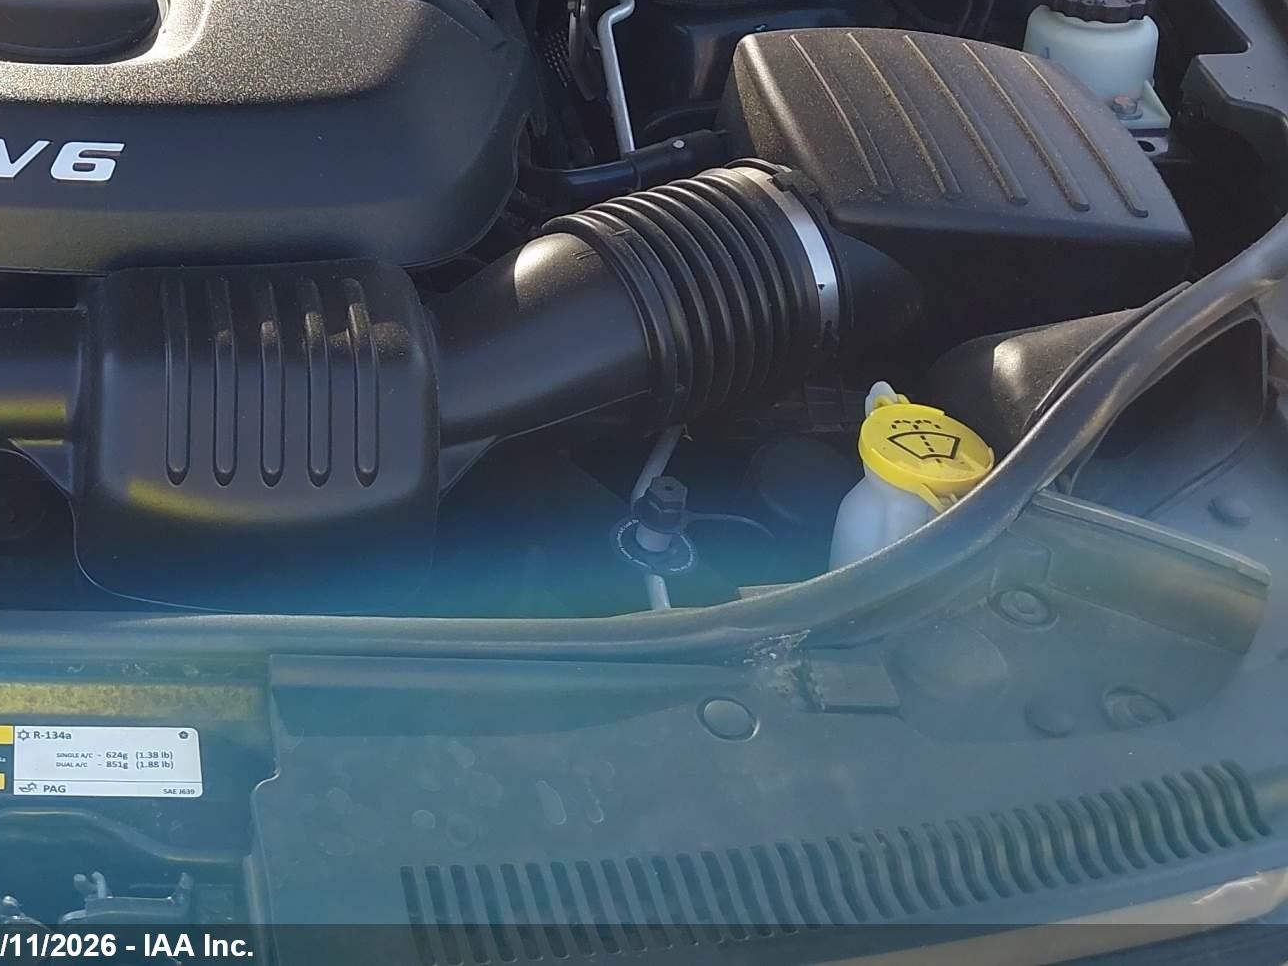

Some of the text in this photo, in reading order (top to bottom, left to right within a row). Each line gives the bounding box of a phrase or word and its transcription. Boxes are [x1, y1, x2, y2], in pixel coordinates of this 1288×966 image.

[33, 730, 72, 740] R-134a
[106, 751, 129, 760] 624g
[135, 751, 159, 760] (1.38
[161, 751, 174, 760] lb)
[106, 760, 129, 770] 851g
[135, 760, 159, 769] (1.88
[161, 760, 174, 769] lb)
[43, 784, 67, 794] PAG
[162, 787, 177, 795] SAE
